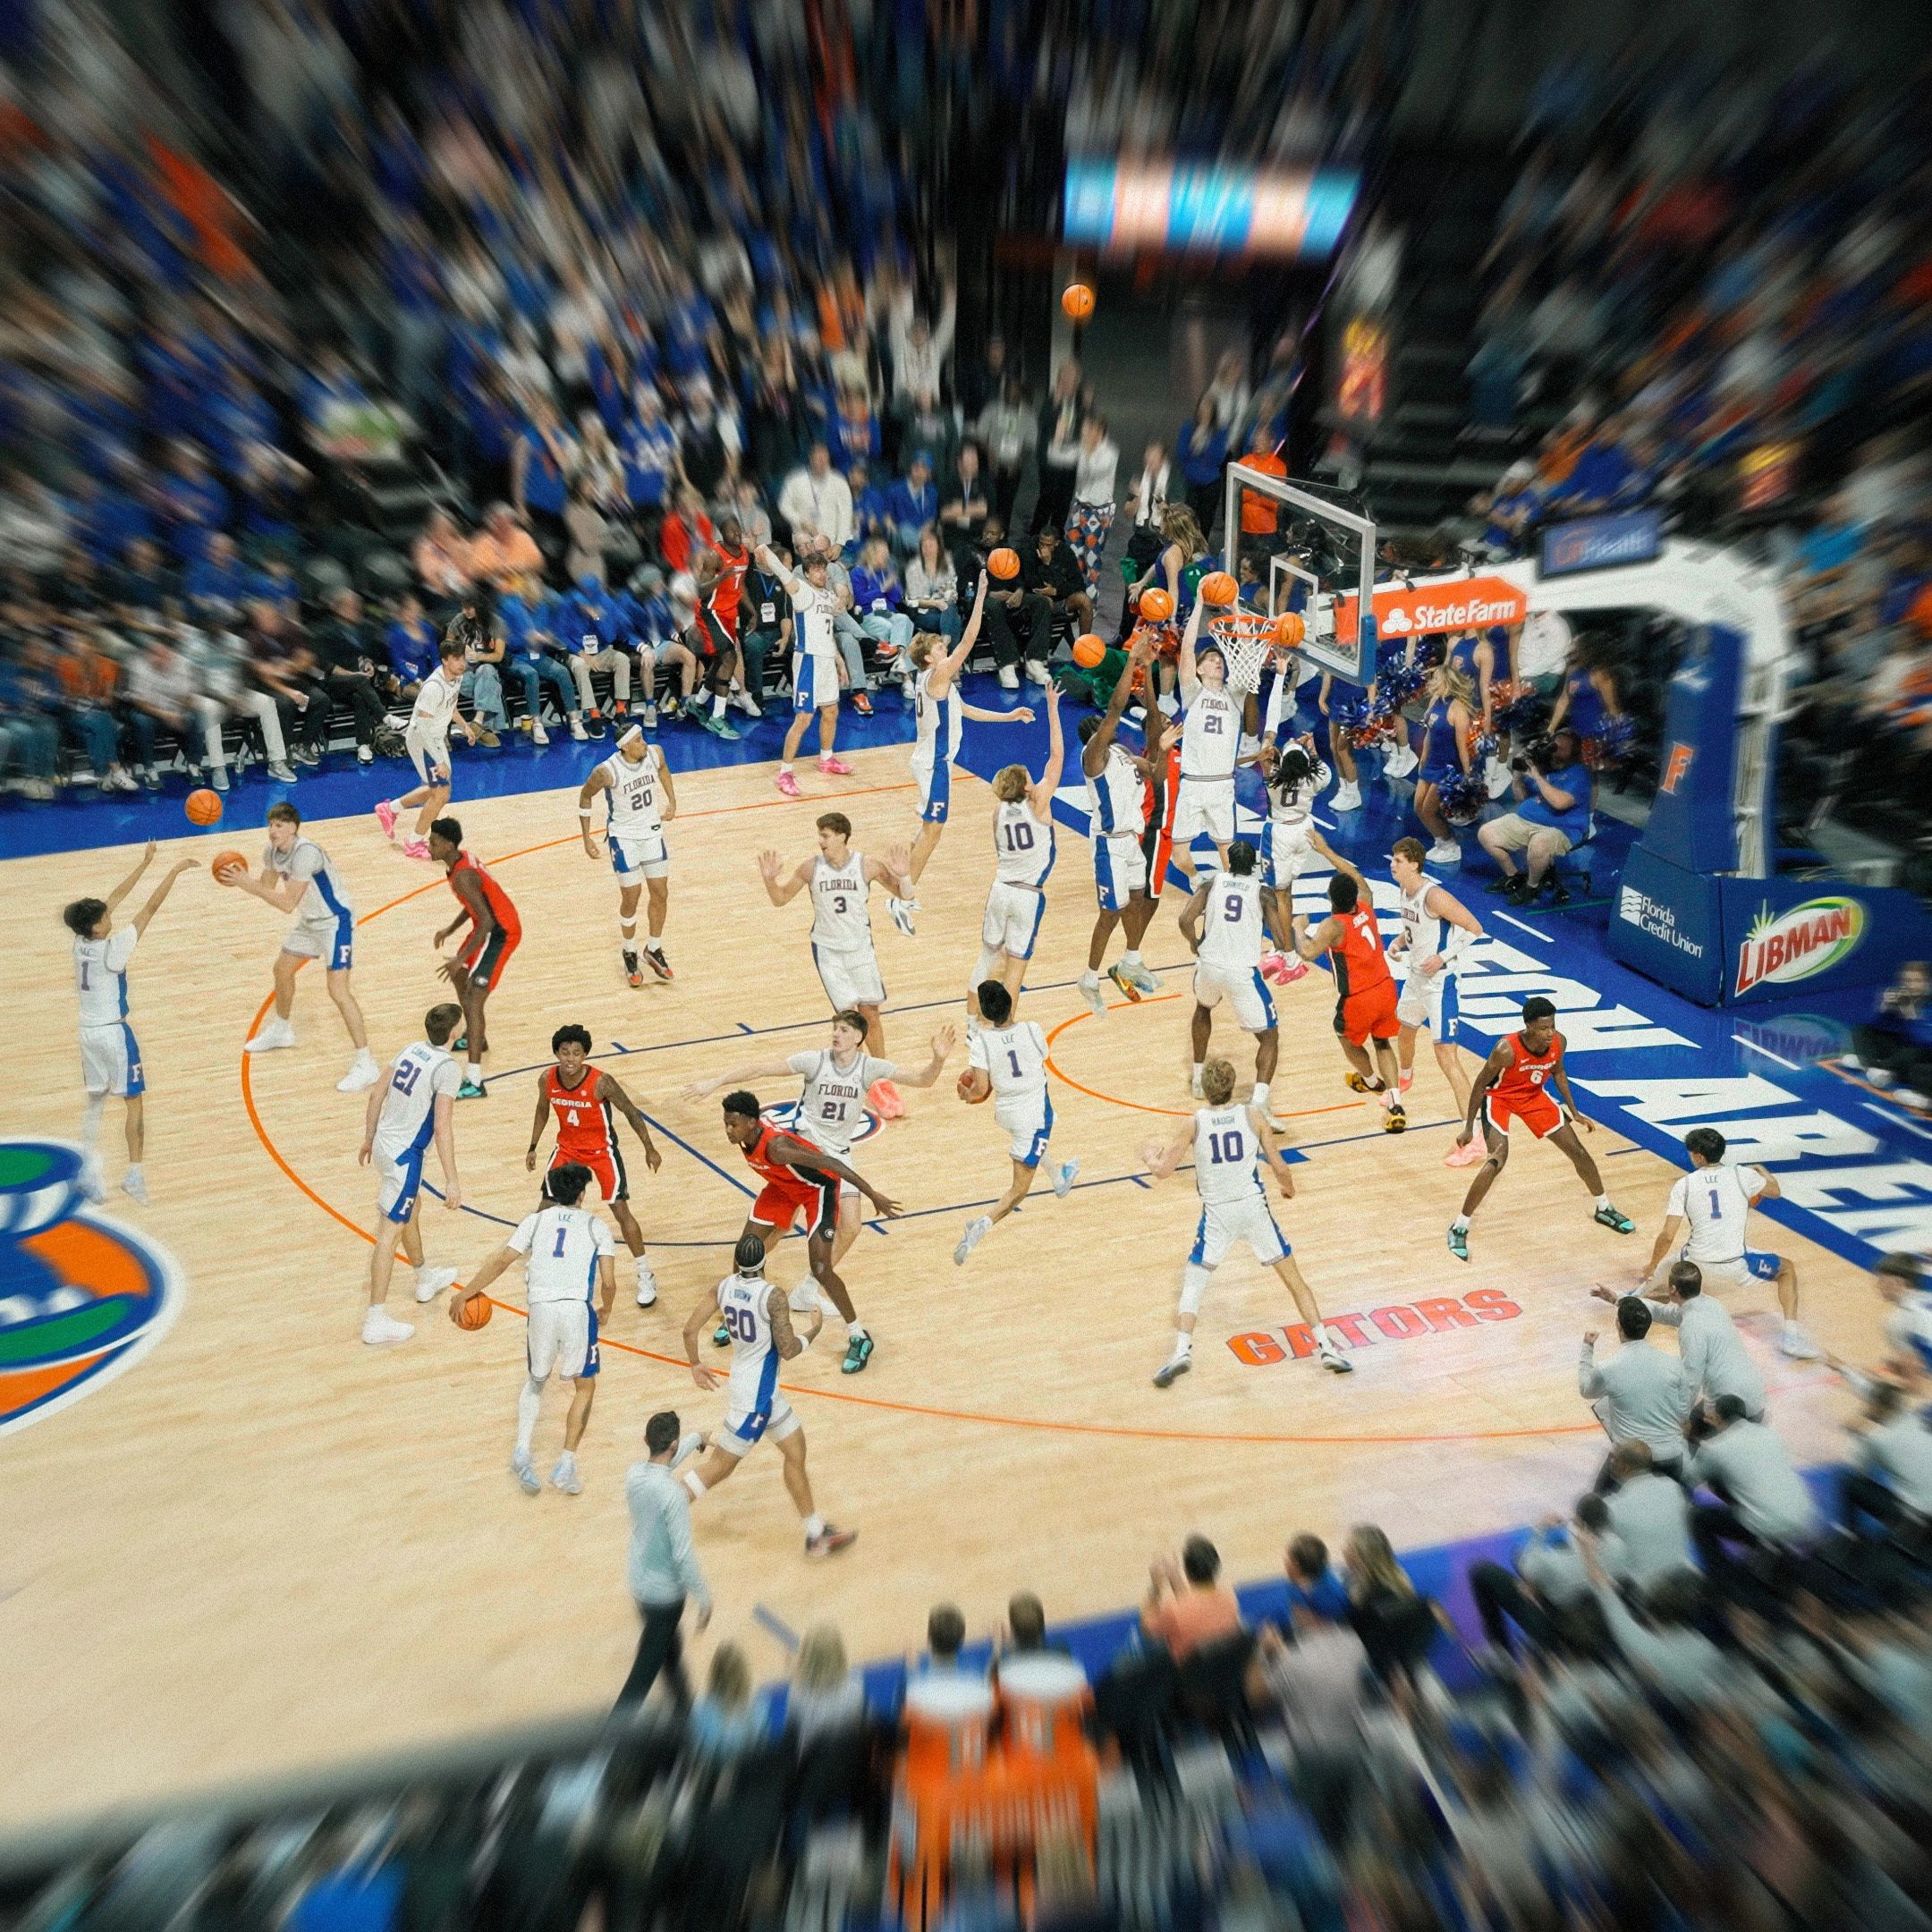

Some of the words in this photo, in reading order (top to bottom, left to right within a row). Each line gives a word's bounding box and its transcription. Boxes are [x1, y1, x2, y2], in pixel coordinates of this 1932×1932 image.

[1204, 716, 1224, 734] 21
[1660, 741, 1694, 795] F
[623, 775, 656, 794] FLORIDA
[631, 789, 652, 810] 20
[1004, 822, 1035, 852] 10
[820, 878, 857, 892] FLORIDA
[834, 896, 847, 913] 3
[1224, 894, 1242, 922] 9
[1641, 896, 1675, 926] Florida
[1360, 925, 1377, 951] 1
[1640, 914, 1671, 942] Credit
[1672, 929, 1703, 959] Union
[1735, 905, 1853, 997] LIBMAN
[81, 962, 89, 991] 1
[1001, 1034, 1015, 1045] LEE
[1007, 1050, 1022, 1078] 1
[1530, 1071, 1544, 1084] 6
[392, 1059, 422, 1097] 21
[818, 1083, 859, 1099] FLORIDA
[550, 1097, 592, 1108] GEORGIA
[822, 1101, 846, 1122] 21
[566, 1108, 580, 1127] 4
[1208, 1131, 1244, 1165] 10
[1704, 1174, 1718, 1184] LEE
[558, 1212, 573, 1223] LEE
[1708, 1189, 1722, 1220] 1
[552, 1227, 567, 1258] 1
[724, 1305, 757, 1343] 20
[1225, 1288, 1523, 1367] GATORS
